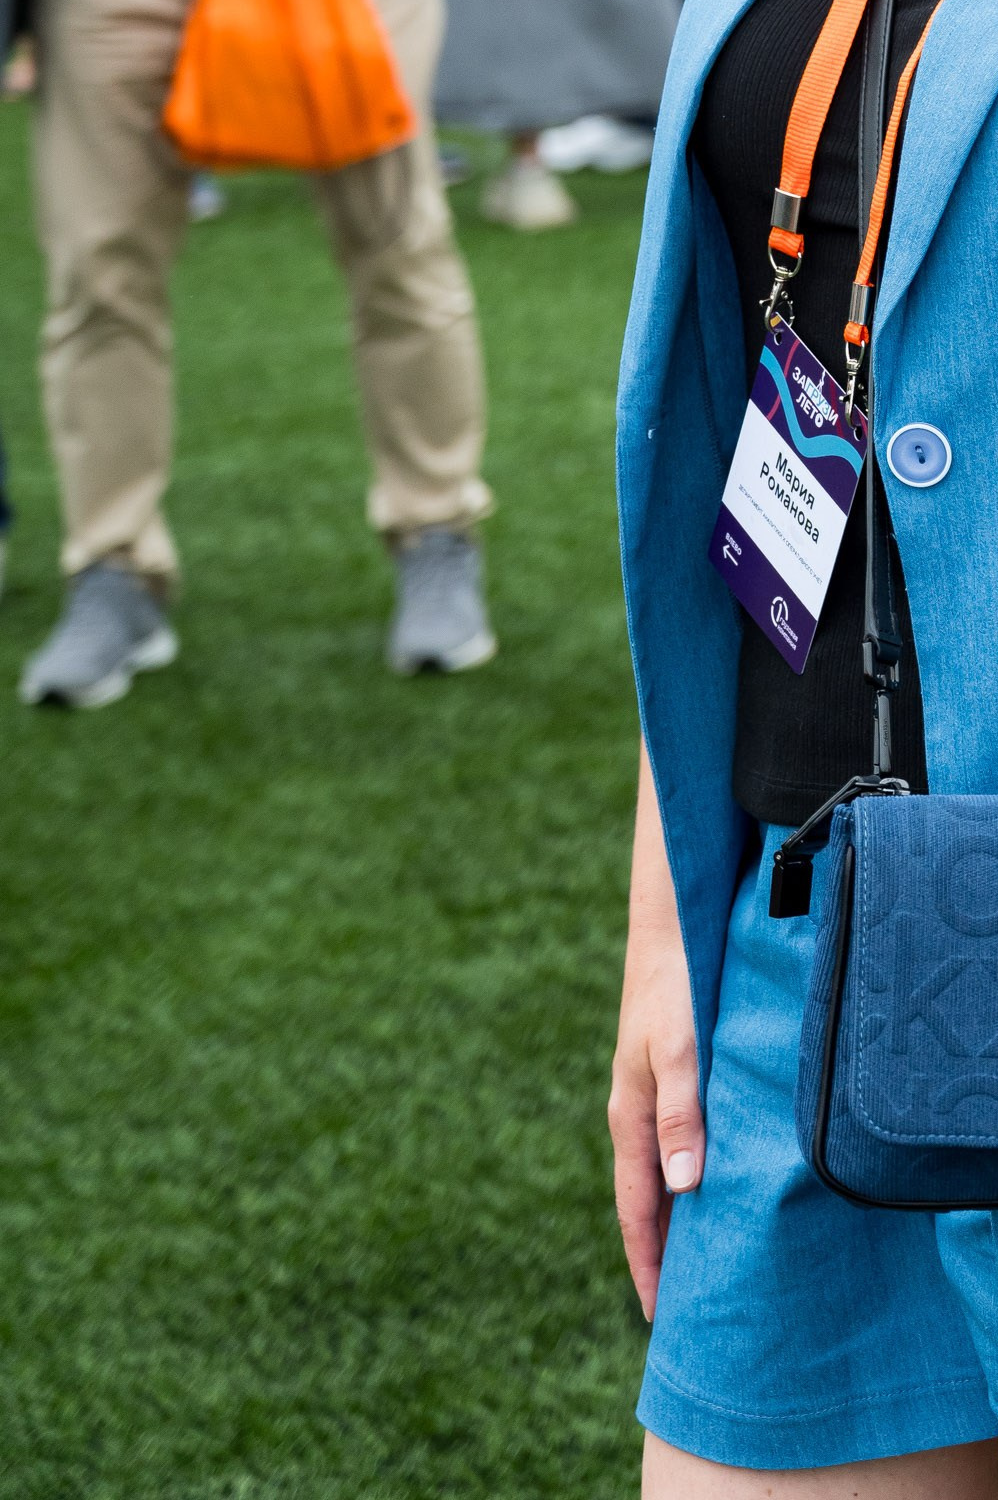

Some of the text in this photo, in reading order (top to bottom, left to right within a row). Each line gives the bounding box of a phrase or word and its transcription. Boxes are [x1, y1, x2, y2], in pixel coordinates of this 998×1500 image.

[792, 366, 839, 426] ЗАГРУЗИ
[795, 392, 824, 428] ЛЕТО
[760, 461, 820, 544] Романова
[775, 451, 815, 510] Мария
[725, 532, 742, 556] ВЛЕВО
